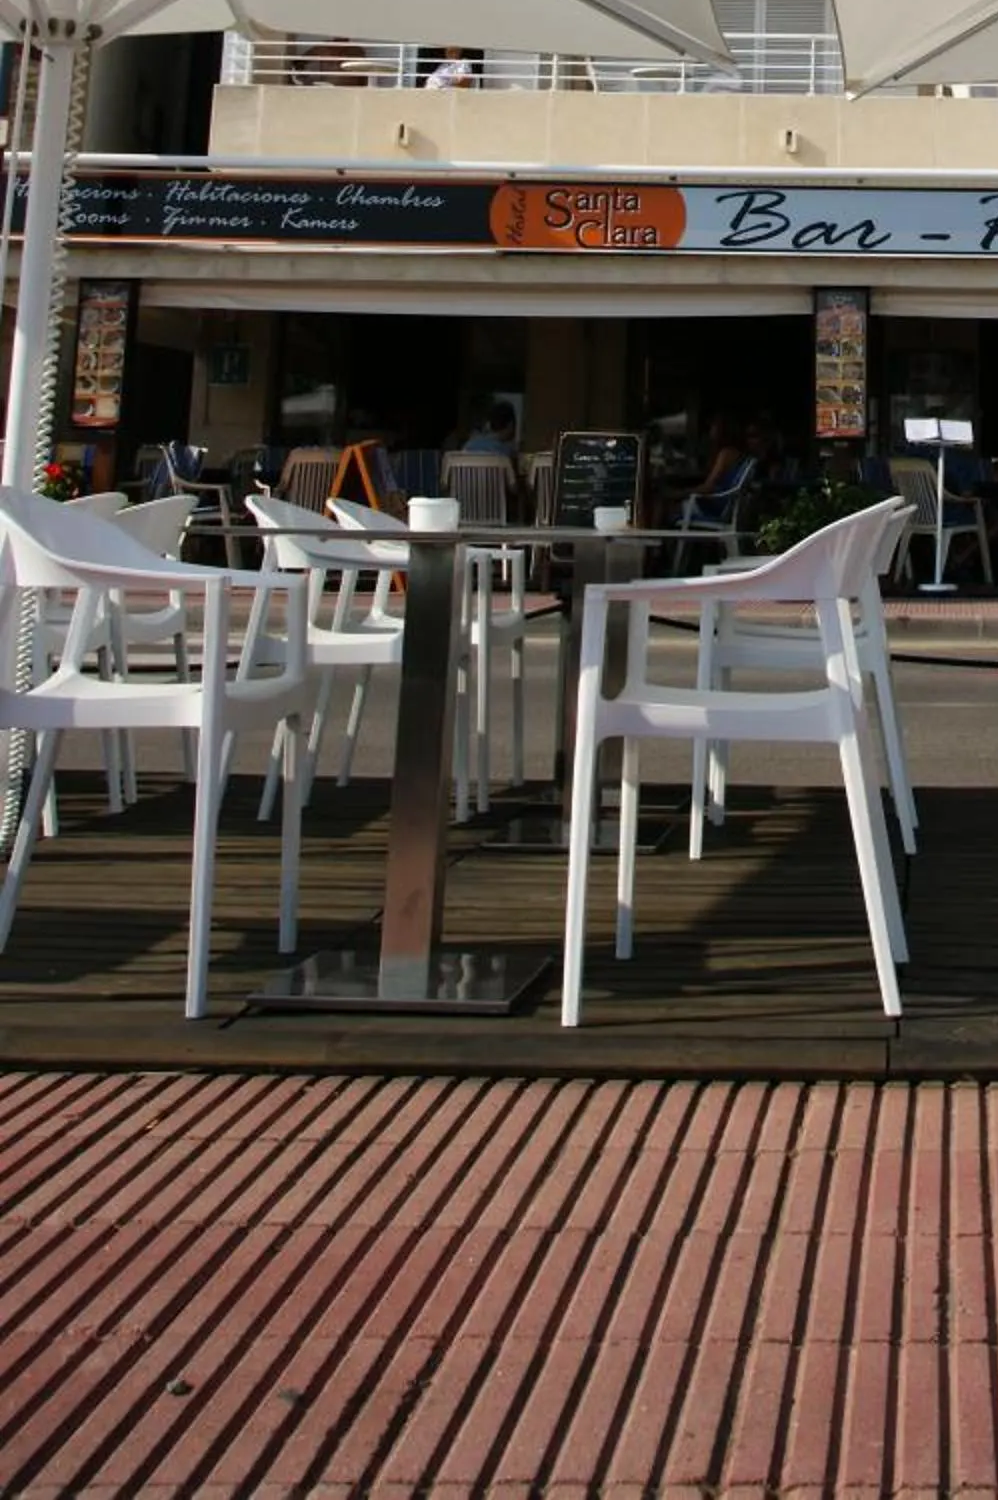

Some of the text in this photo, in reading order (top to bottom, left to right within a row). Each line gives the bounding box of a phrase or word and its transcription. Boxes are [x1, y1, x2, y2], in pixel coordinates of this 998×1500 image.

[166, 180, 310, 204] Habitaciones
[336, 183, 445, 207] Chambres
[281, 206, 360, 230] Kamers
[544, 188, 641, 231] Santa
[715, 190, 892, 249] Bar
[575, 218, 660, 249] Clara
